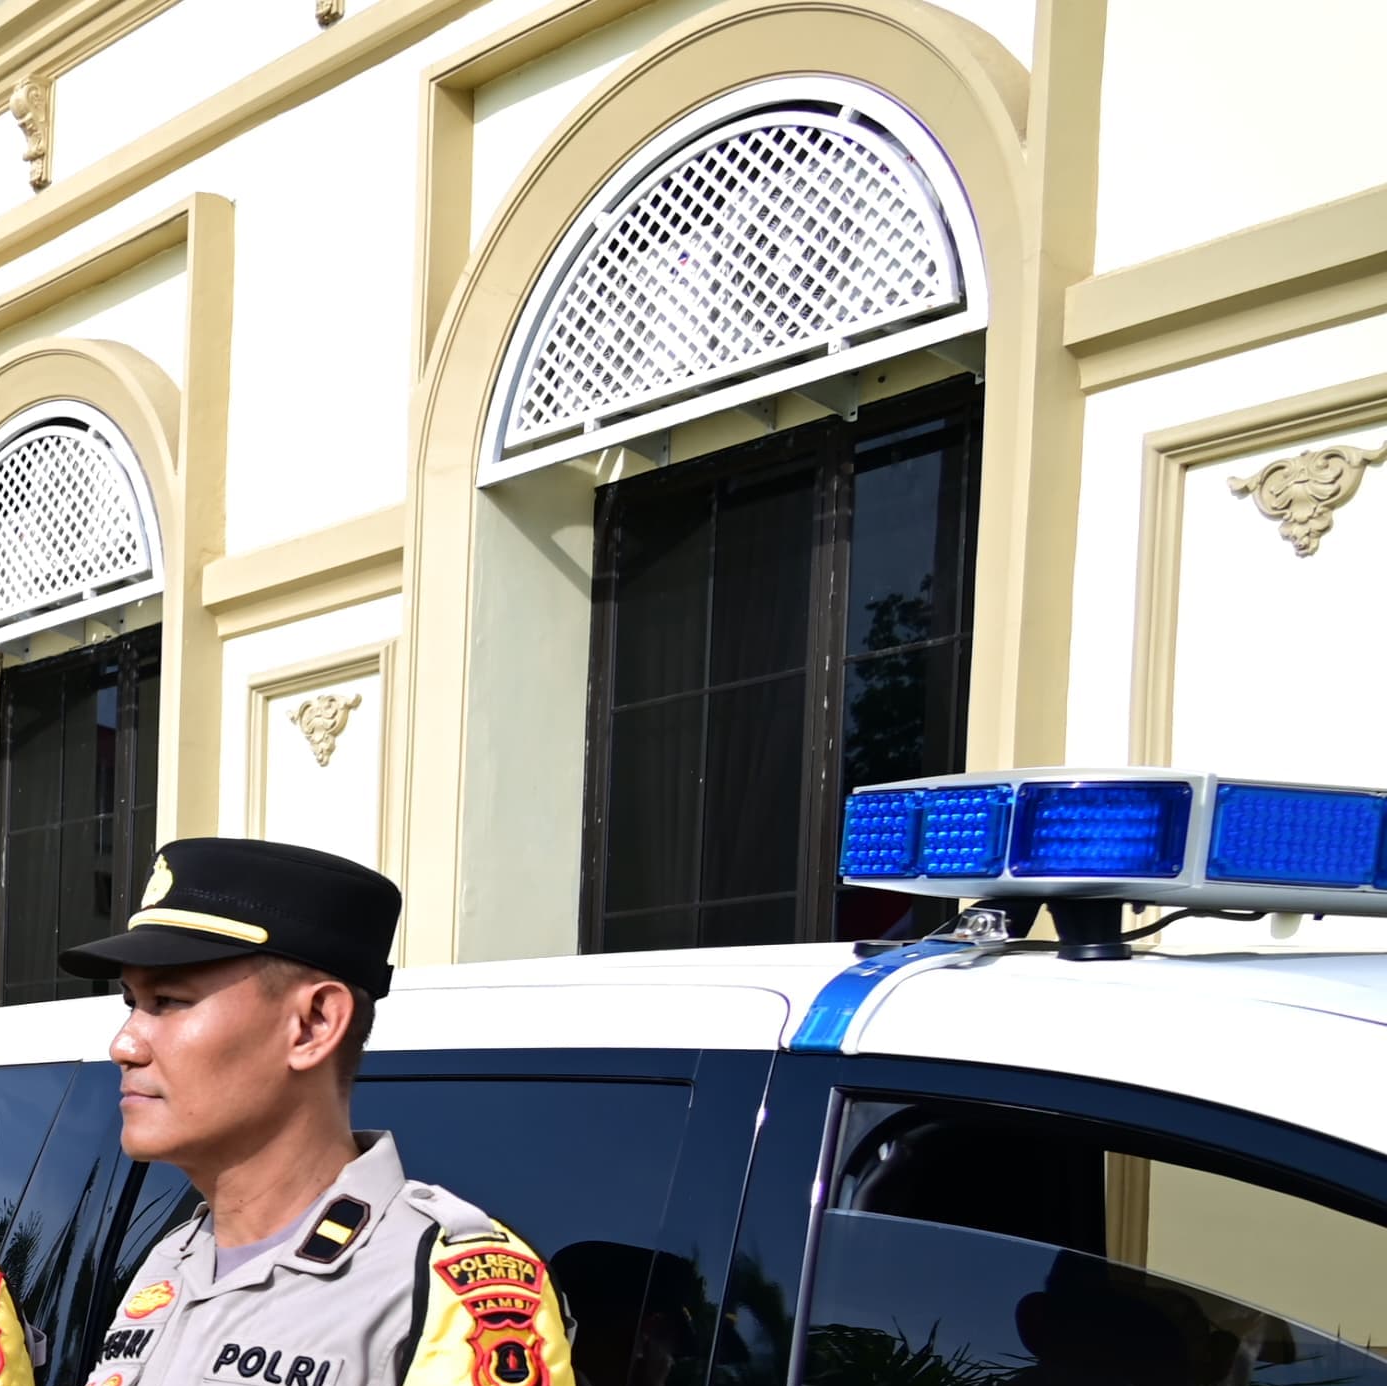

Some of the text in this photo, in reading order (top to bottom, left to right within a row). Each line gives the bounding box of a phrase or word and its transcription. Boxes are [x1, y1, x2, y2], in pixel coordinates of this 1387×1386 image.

[447, 1254, 535, 1279] POLRESTA
[467, 1267, 525, 1284] JAMBI
[474, 1297, 530, 1312] JAMBI
